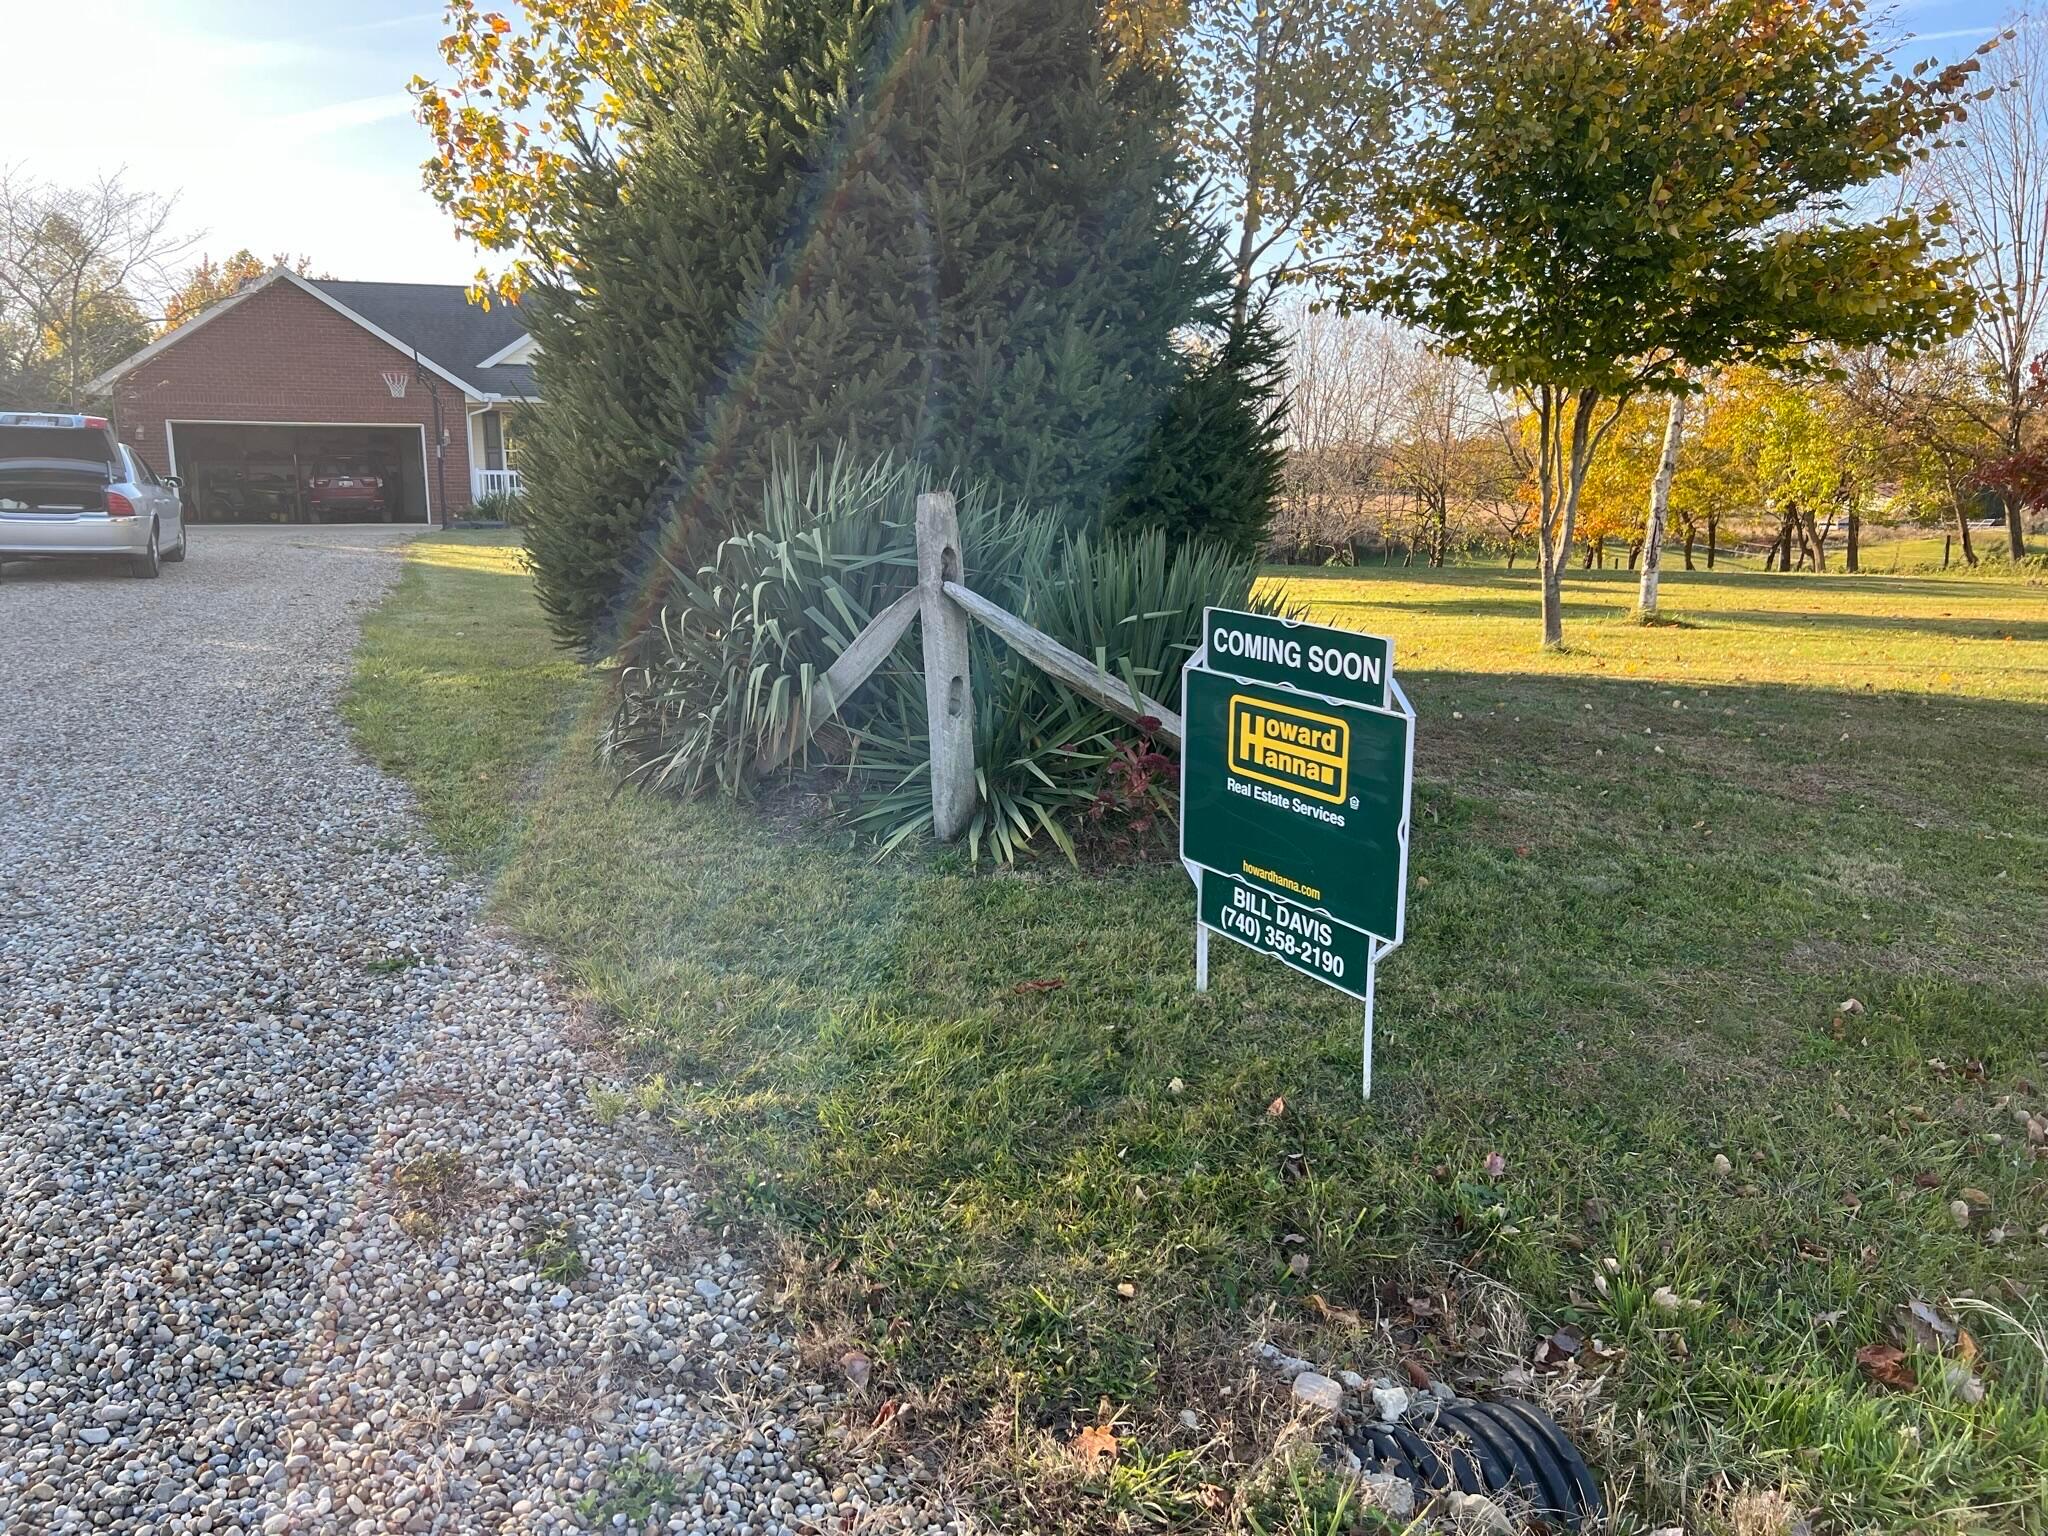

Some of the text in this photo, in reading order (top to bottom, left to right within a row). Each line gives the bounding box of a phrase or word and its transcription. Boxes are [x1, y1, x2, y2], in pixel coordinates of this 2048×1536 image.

[1213, 627, 1380, 685] COMING SOON
[1239, 730, 1323, 783] Hanna
[1240, 711, 1336, 757] Howard
[1227, 777, 1346, 828] Real Estate Services
[1242, 859, 1321, 901] howardhanna.com
[1220, 905, 1345, 978] (740) 358-2190
[1233, 886, 1333, 947] BILL DAVIS
